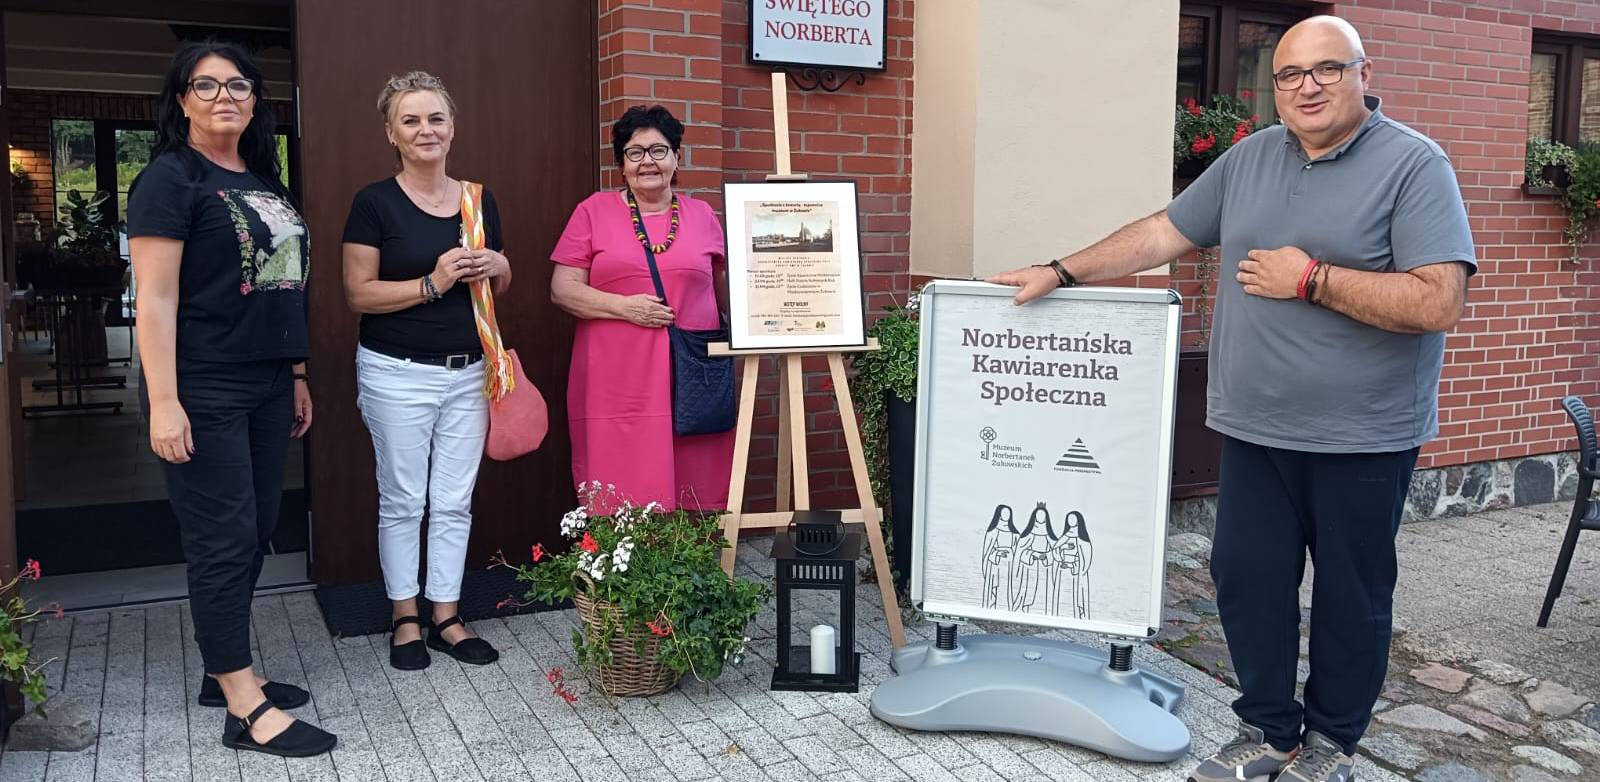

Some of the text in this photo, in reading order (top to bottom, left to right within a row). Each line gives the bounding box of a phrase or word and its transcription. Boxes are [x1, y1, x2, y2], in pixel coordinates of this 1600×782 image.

[765, 20, 872, 46] NORBERTA
[961, 328, 1133, 355] Norbertańska
[972, 354, 1119, 381] Kawiarenka
[980, 380, 1107, 407] Społeczna
[992, 443, 1022, 452] Muzeum
[992, 451, 1036, 461] Norbertanek
